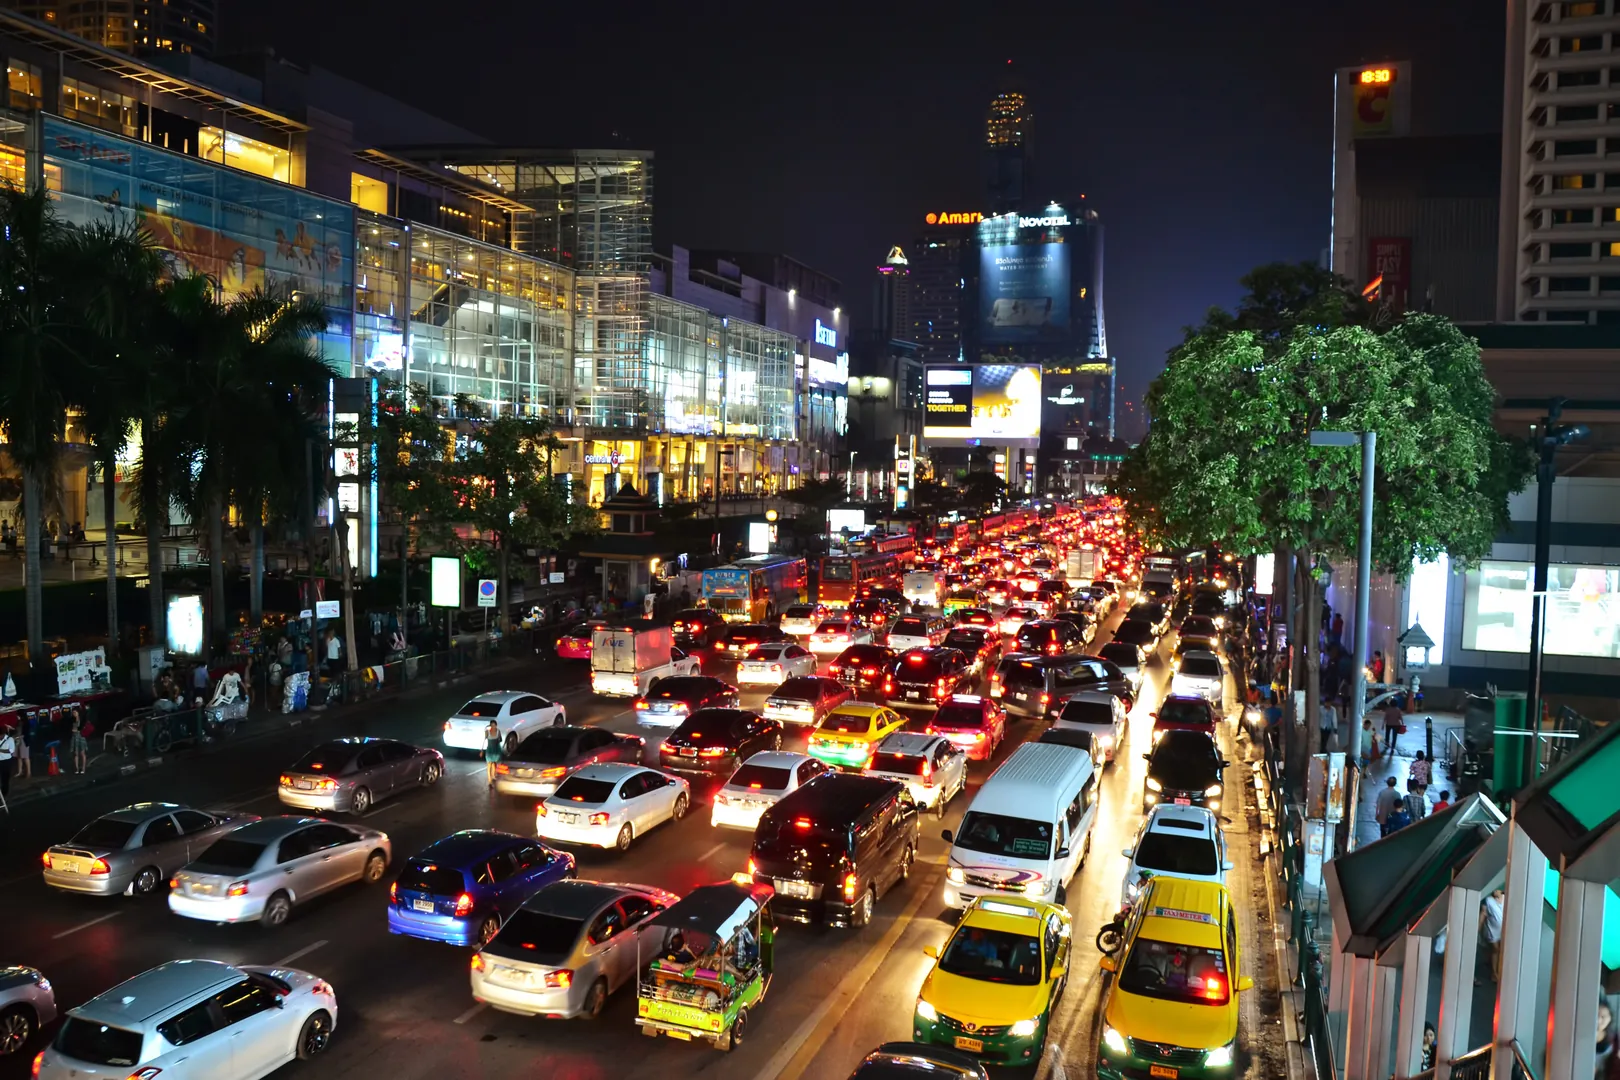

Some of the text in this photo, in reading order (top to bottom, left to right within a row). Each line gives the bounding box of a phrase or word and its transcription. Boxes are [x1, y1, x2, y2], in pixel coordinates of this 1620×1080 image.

[1361, 69, 1389, 83] 18:30
[1019, 214, 1072, 228] NOVOTEL
[1376, 256, 1402, 272] EASY
[926, 404, 967, 412] TOGETHER
[602, 636, 625, 647] KWE
[1163, 909, 1202, 920] TAXI METER
